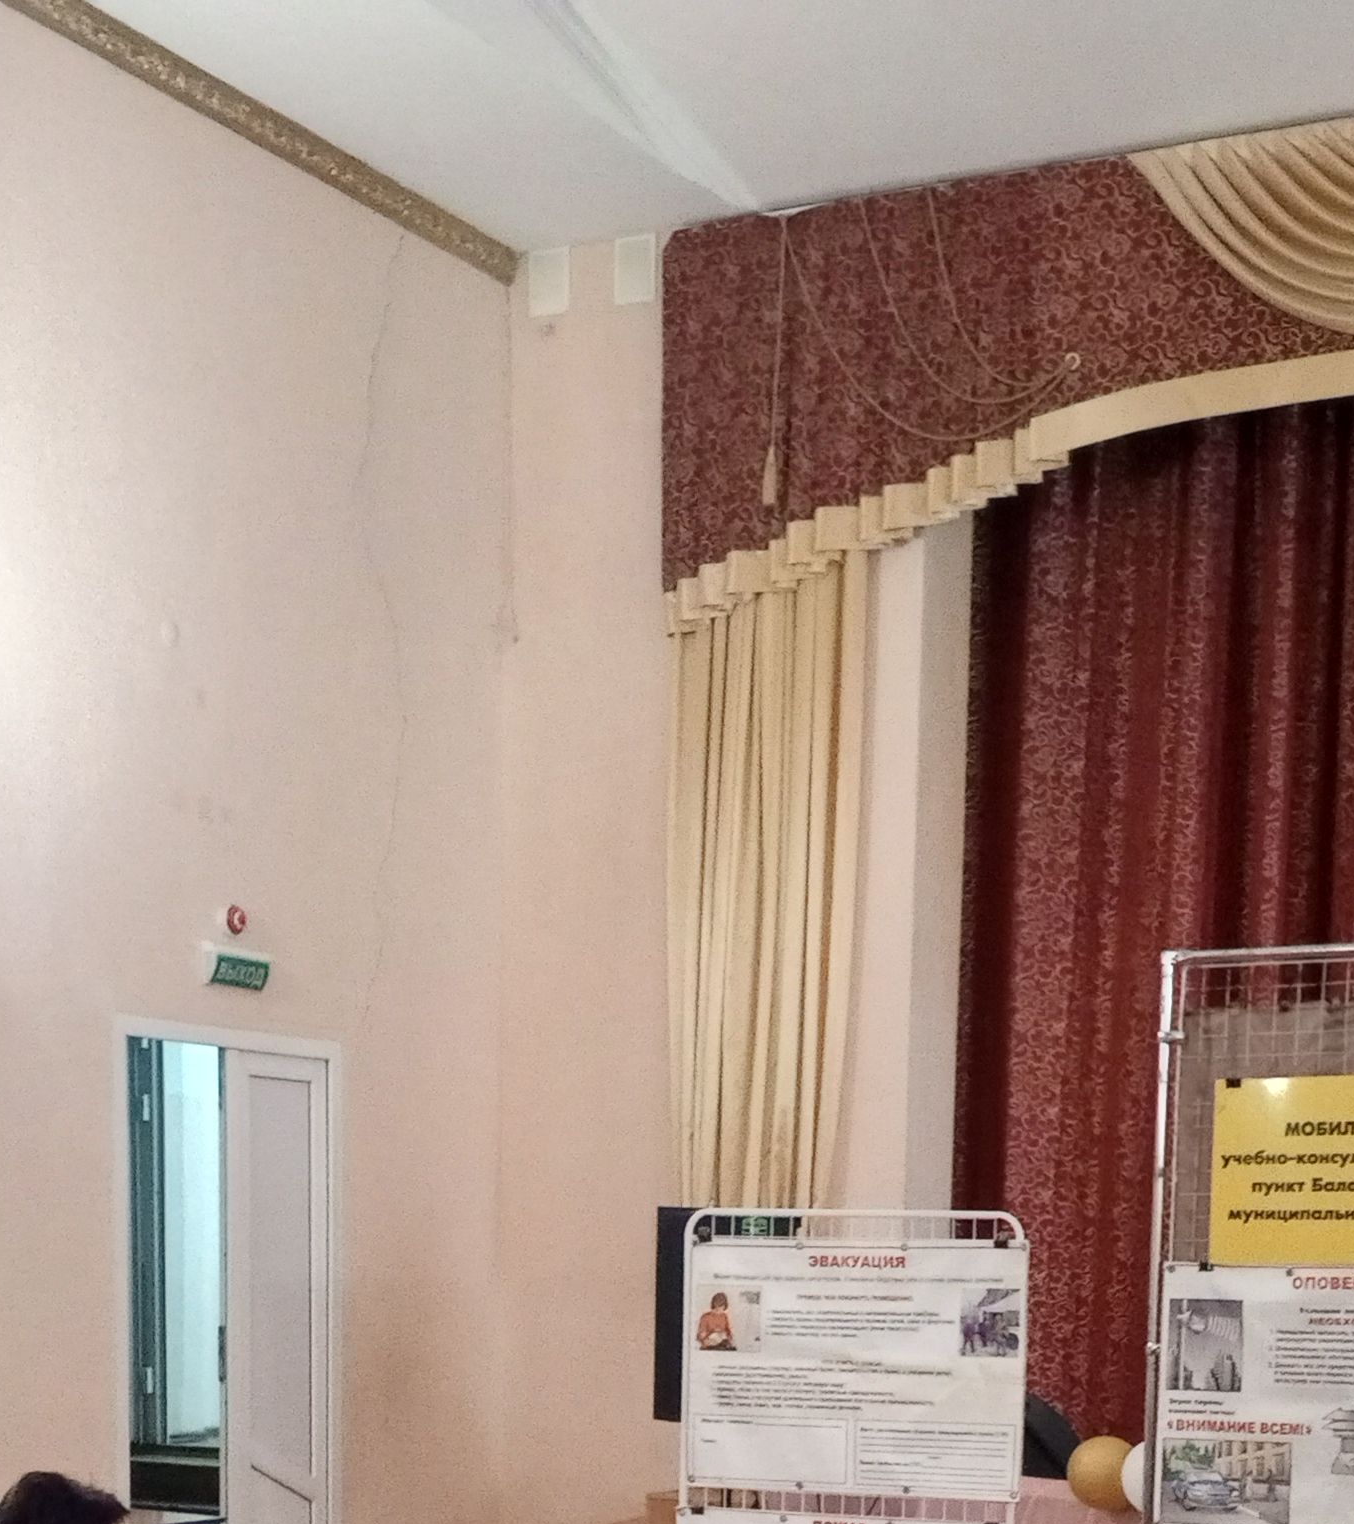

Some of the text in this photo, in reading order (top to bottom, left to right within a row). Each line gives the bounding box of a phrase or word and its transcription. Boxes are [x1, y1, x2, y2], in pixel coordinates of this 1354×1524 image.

[216, 961, 266, 988] ВЫХОД
[1252, 1181, 1304, 1196] пункт
[808, 1255, 906, 1269] ЭВАКУАЦИЯ
